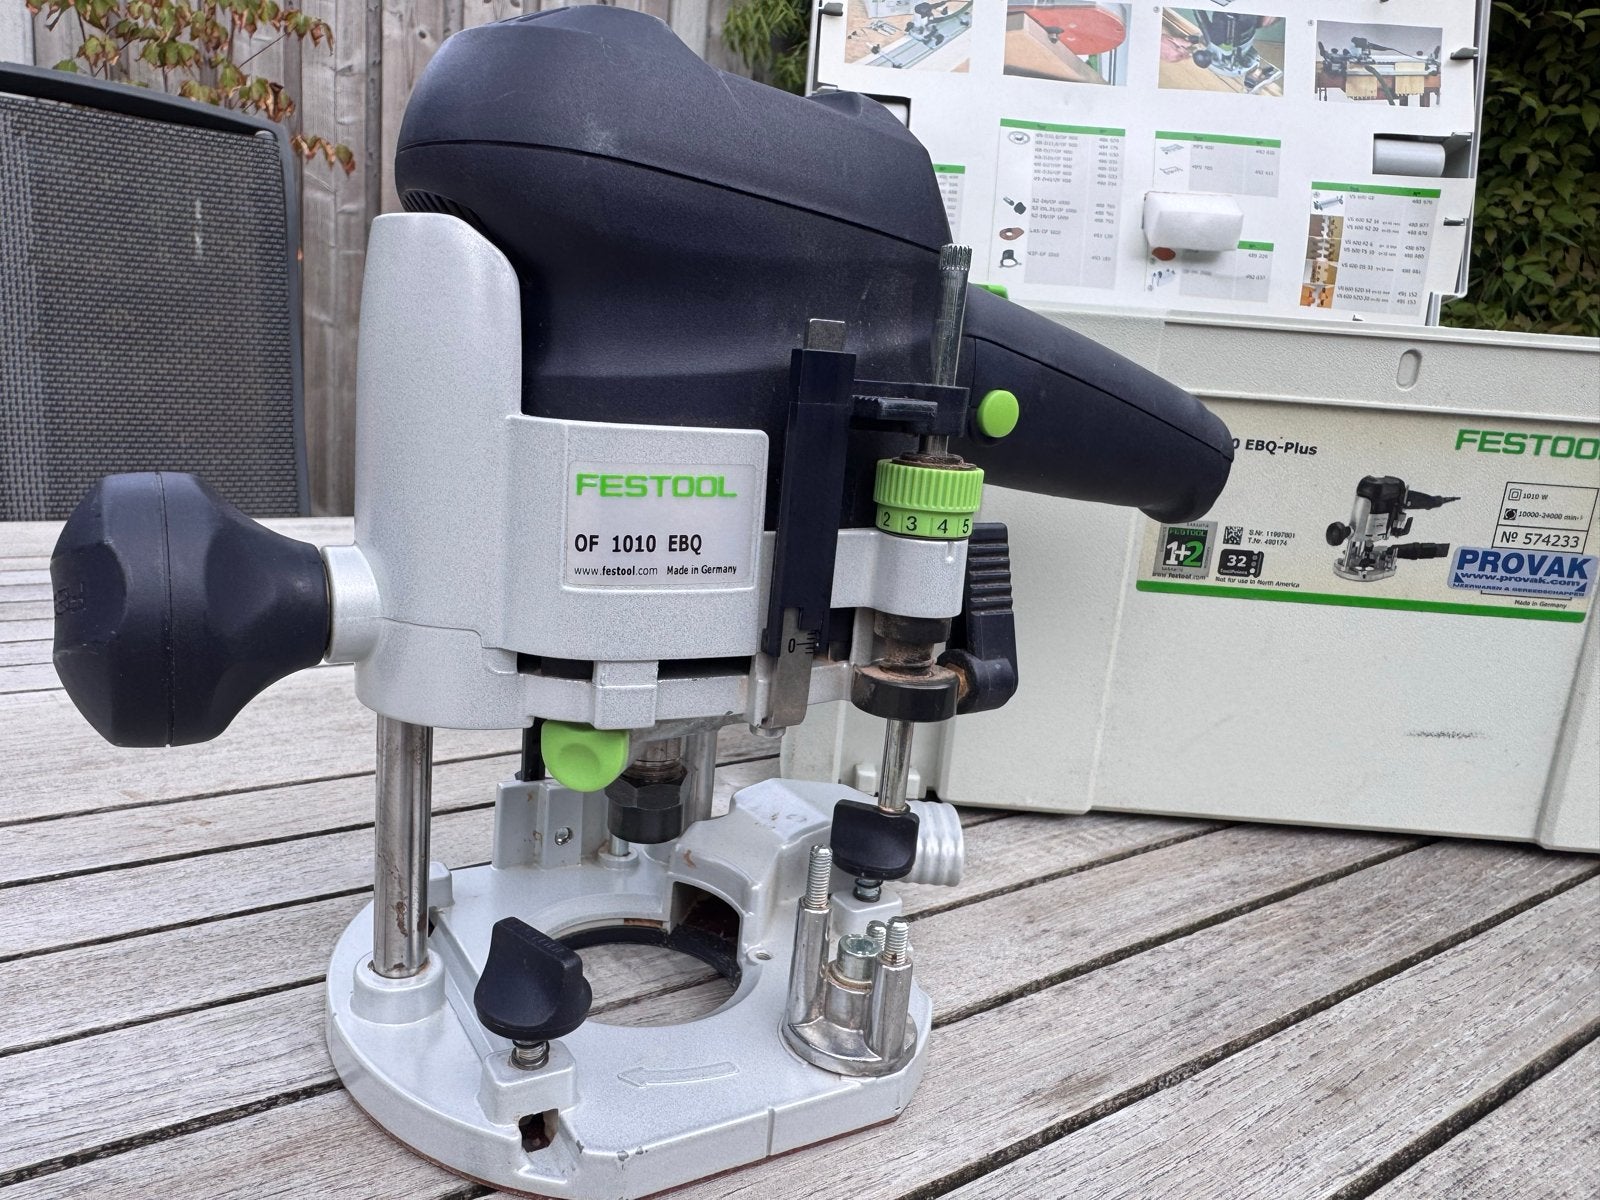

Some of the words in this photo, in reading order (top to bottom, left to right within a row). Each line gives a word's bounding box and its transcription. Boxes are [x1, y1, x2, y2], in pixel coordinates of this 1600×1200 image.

[1245, 439, 1318, 456] EBQ-Plus
[1455, 429, 1600, 460] FESTOO
[576, 473, 737, 498] FESTOOL
[883, 512, 891, 527] 2
[906, 516, 917, 531] 3
[937, 519, 948, 534] 4
[962, 519, 969, 534] 5
[575, 533, 600, 552] OF
[612, 534, 656, 553] 1010
[668, 534, 702, 555] EBQ
[1523, 532, 1580, 548] 574233
[1227, 554, 1247, 567] 32
[1457, 549, 1592, 579] PROVAK
[574, 565, 658, 576] www.festool.com
[667, 565, 689, 575] Made
[691, 565, 699, 575] in
[701, 564, 737, 575] Germany
[1460, 573, 1580, 587] www.provak.com
[1539, 601, 1567, 609] Germany
[788, 638, 796, 653] 0
